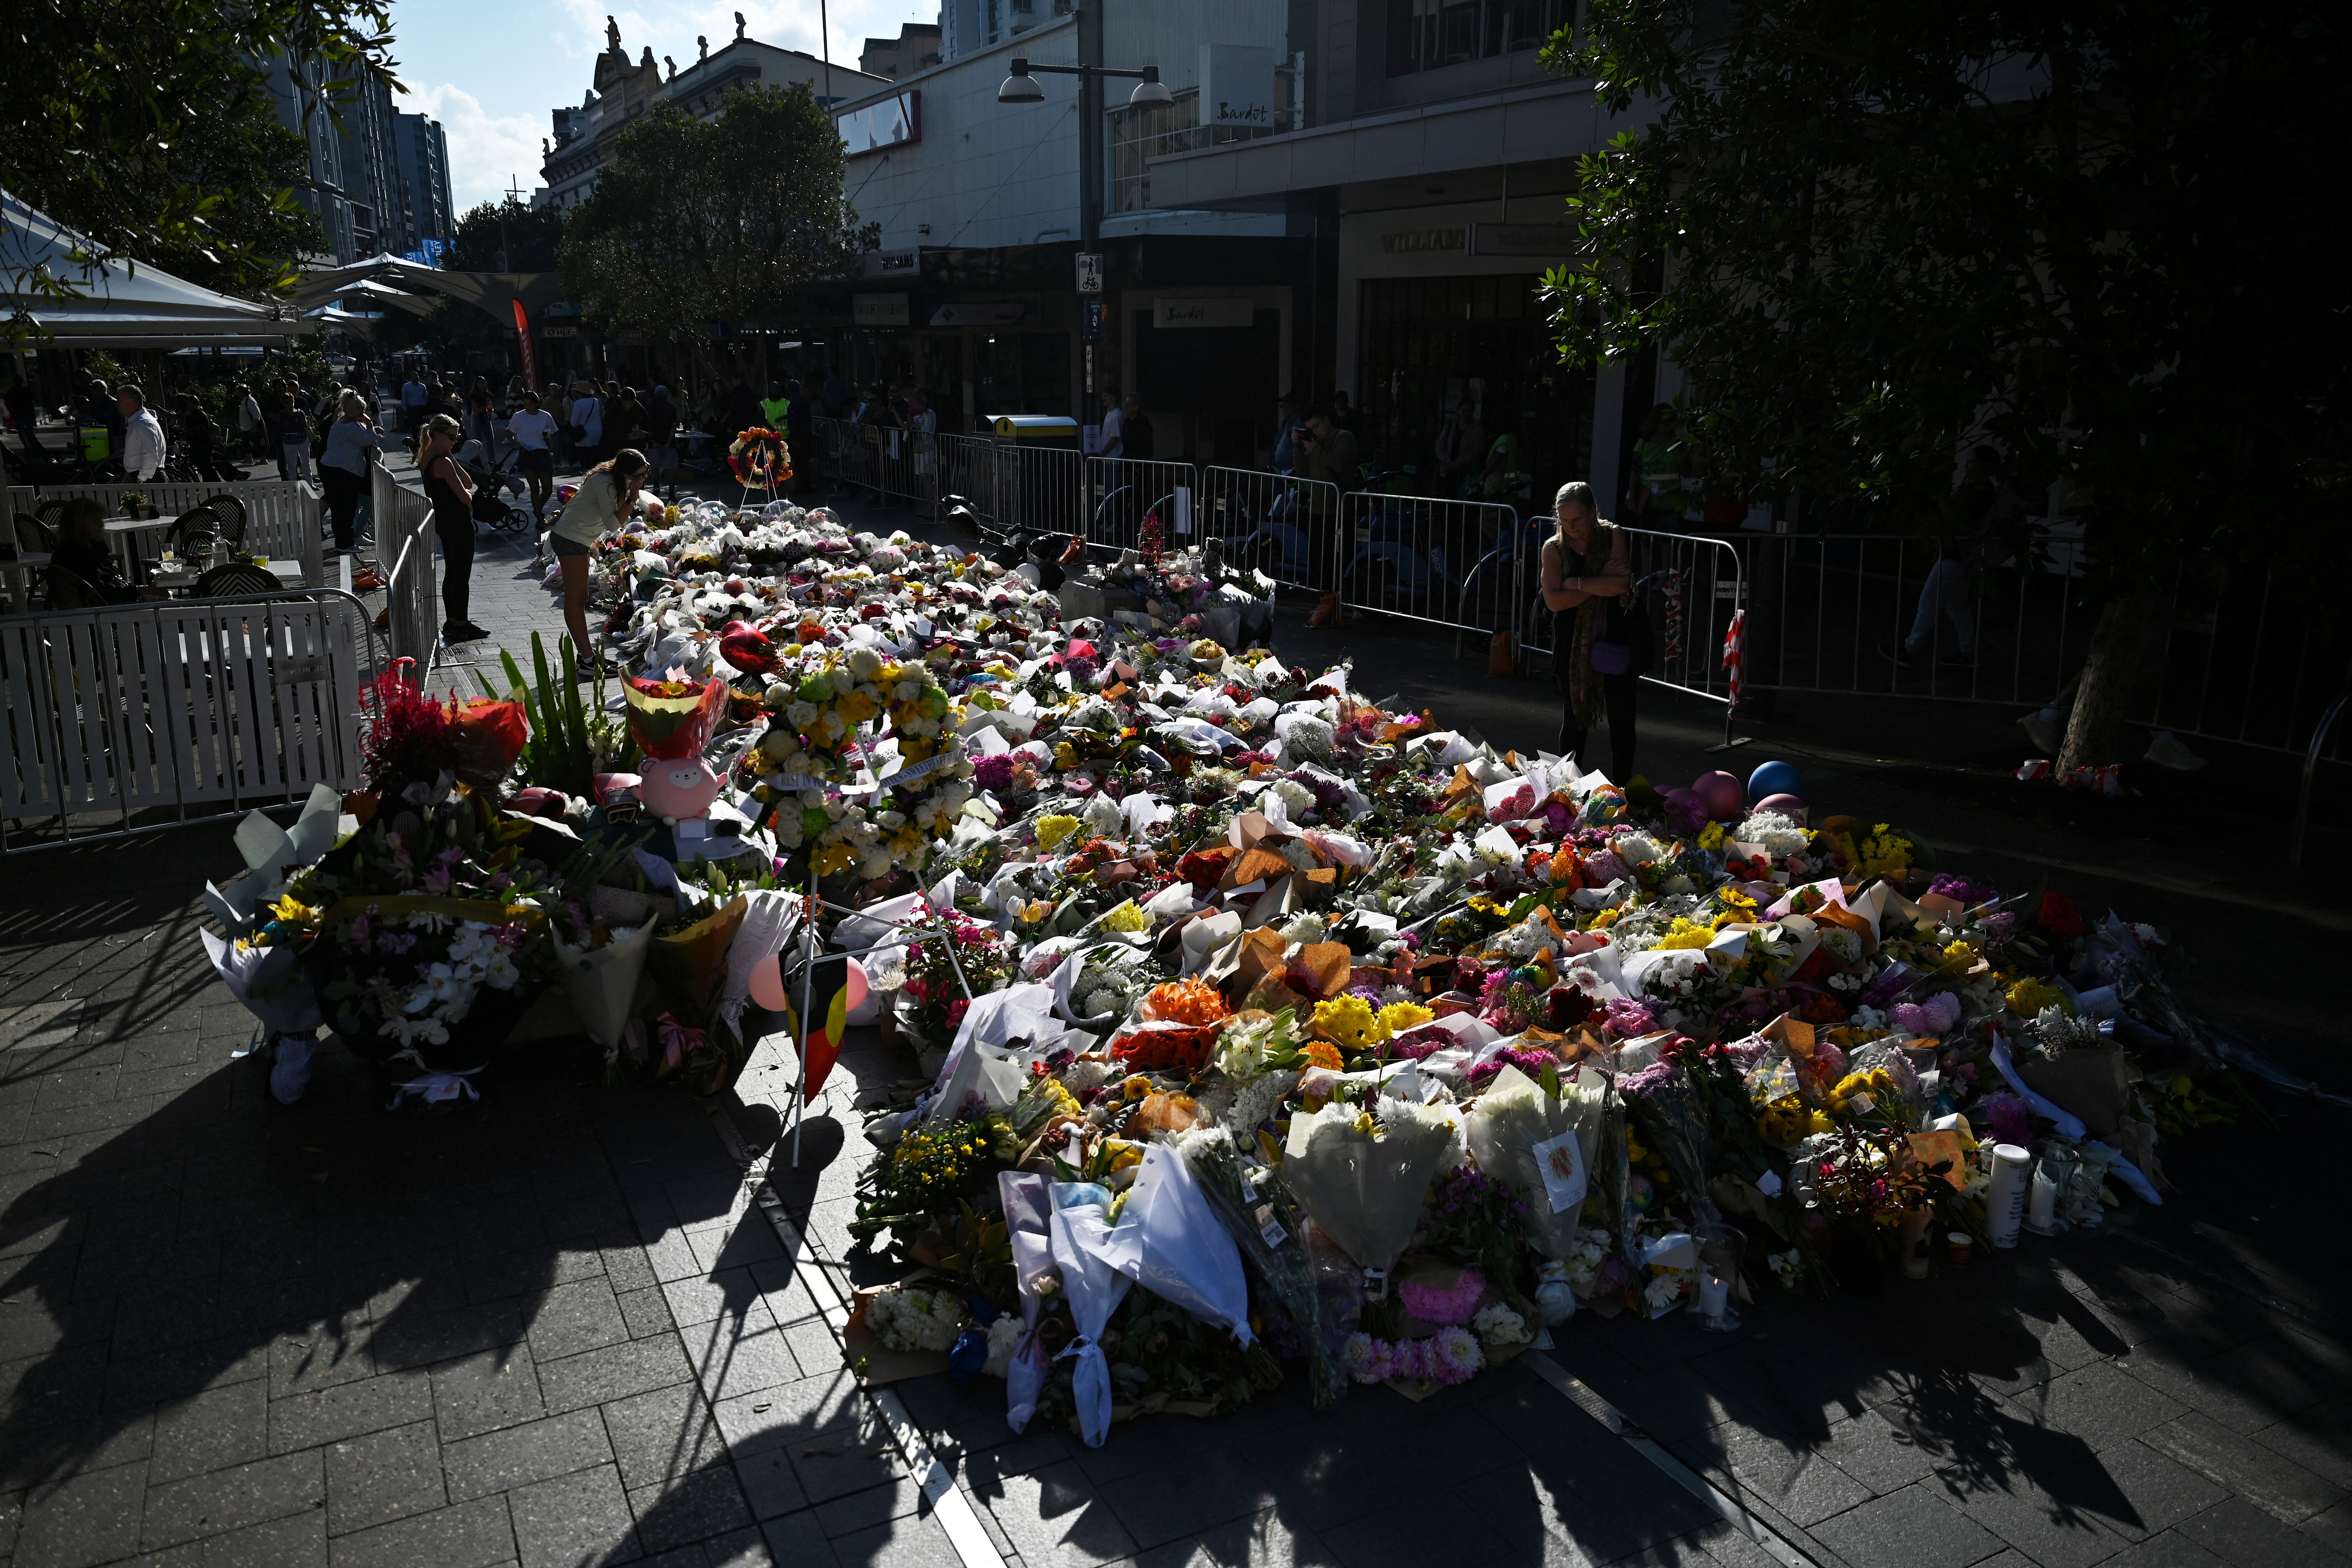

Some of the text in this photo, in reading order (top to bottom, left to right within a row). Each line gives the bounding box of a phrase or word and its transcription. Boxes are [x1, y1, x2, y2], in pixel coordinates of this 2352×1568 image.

[882, 254, 914, 270] WILLIAMS
[906, 755, 946, 777] SWEETHEART
[781, 773, 800, 787] REST
[803, 774, 811, 787] IN
